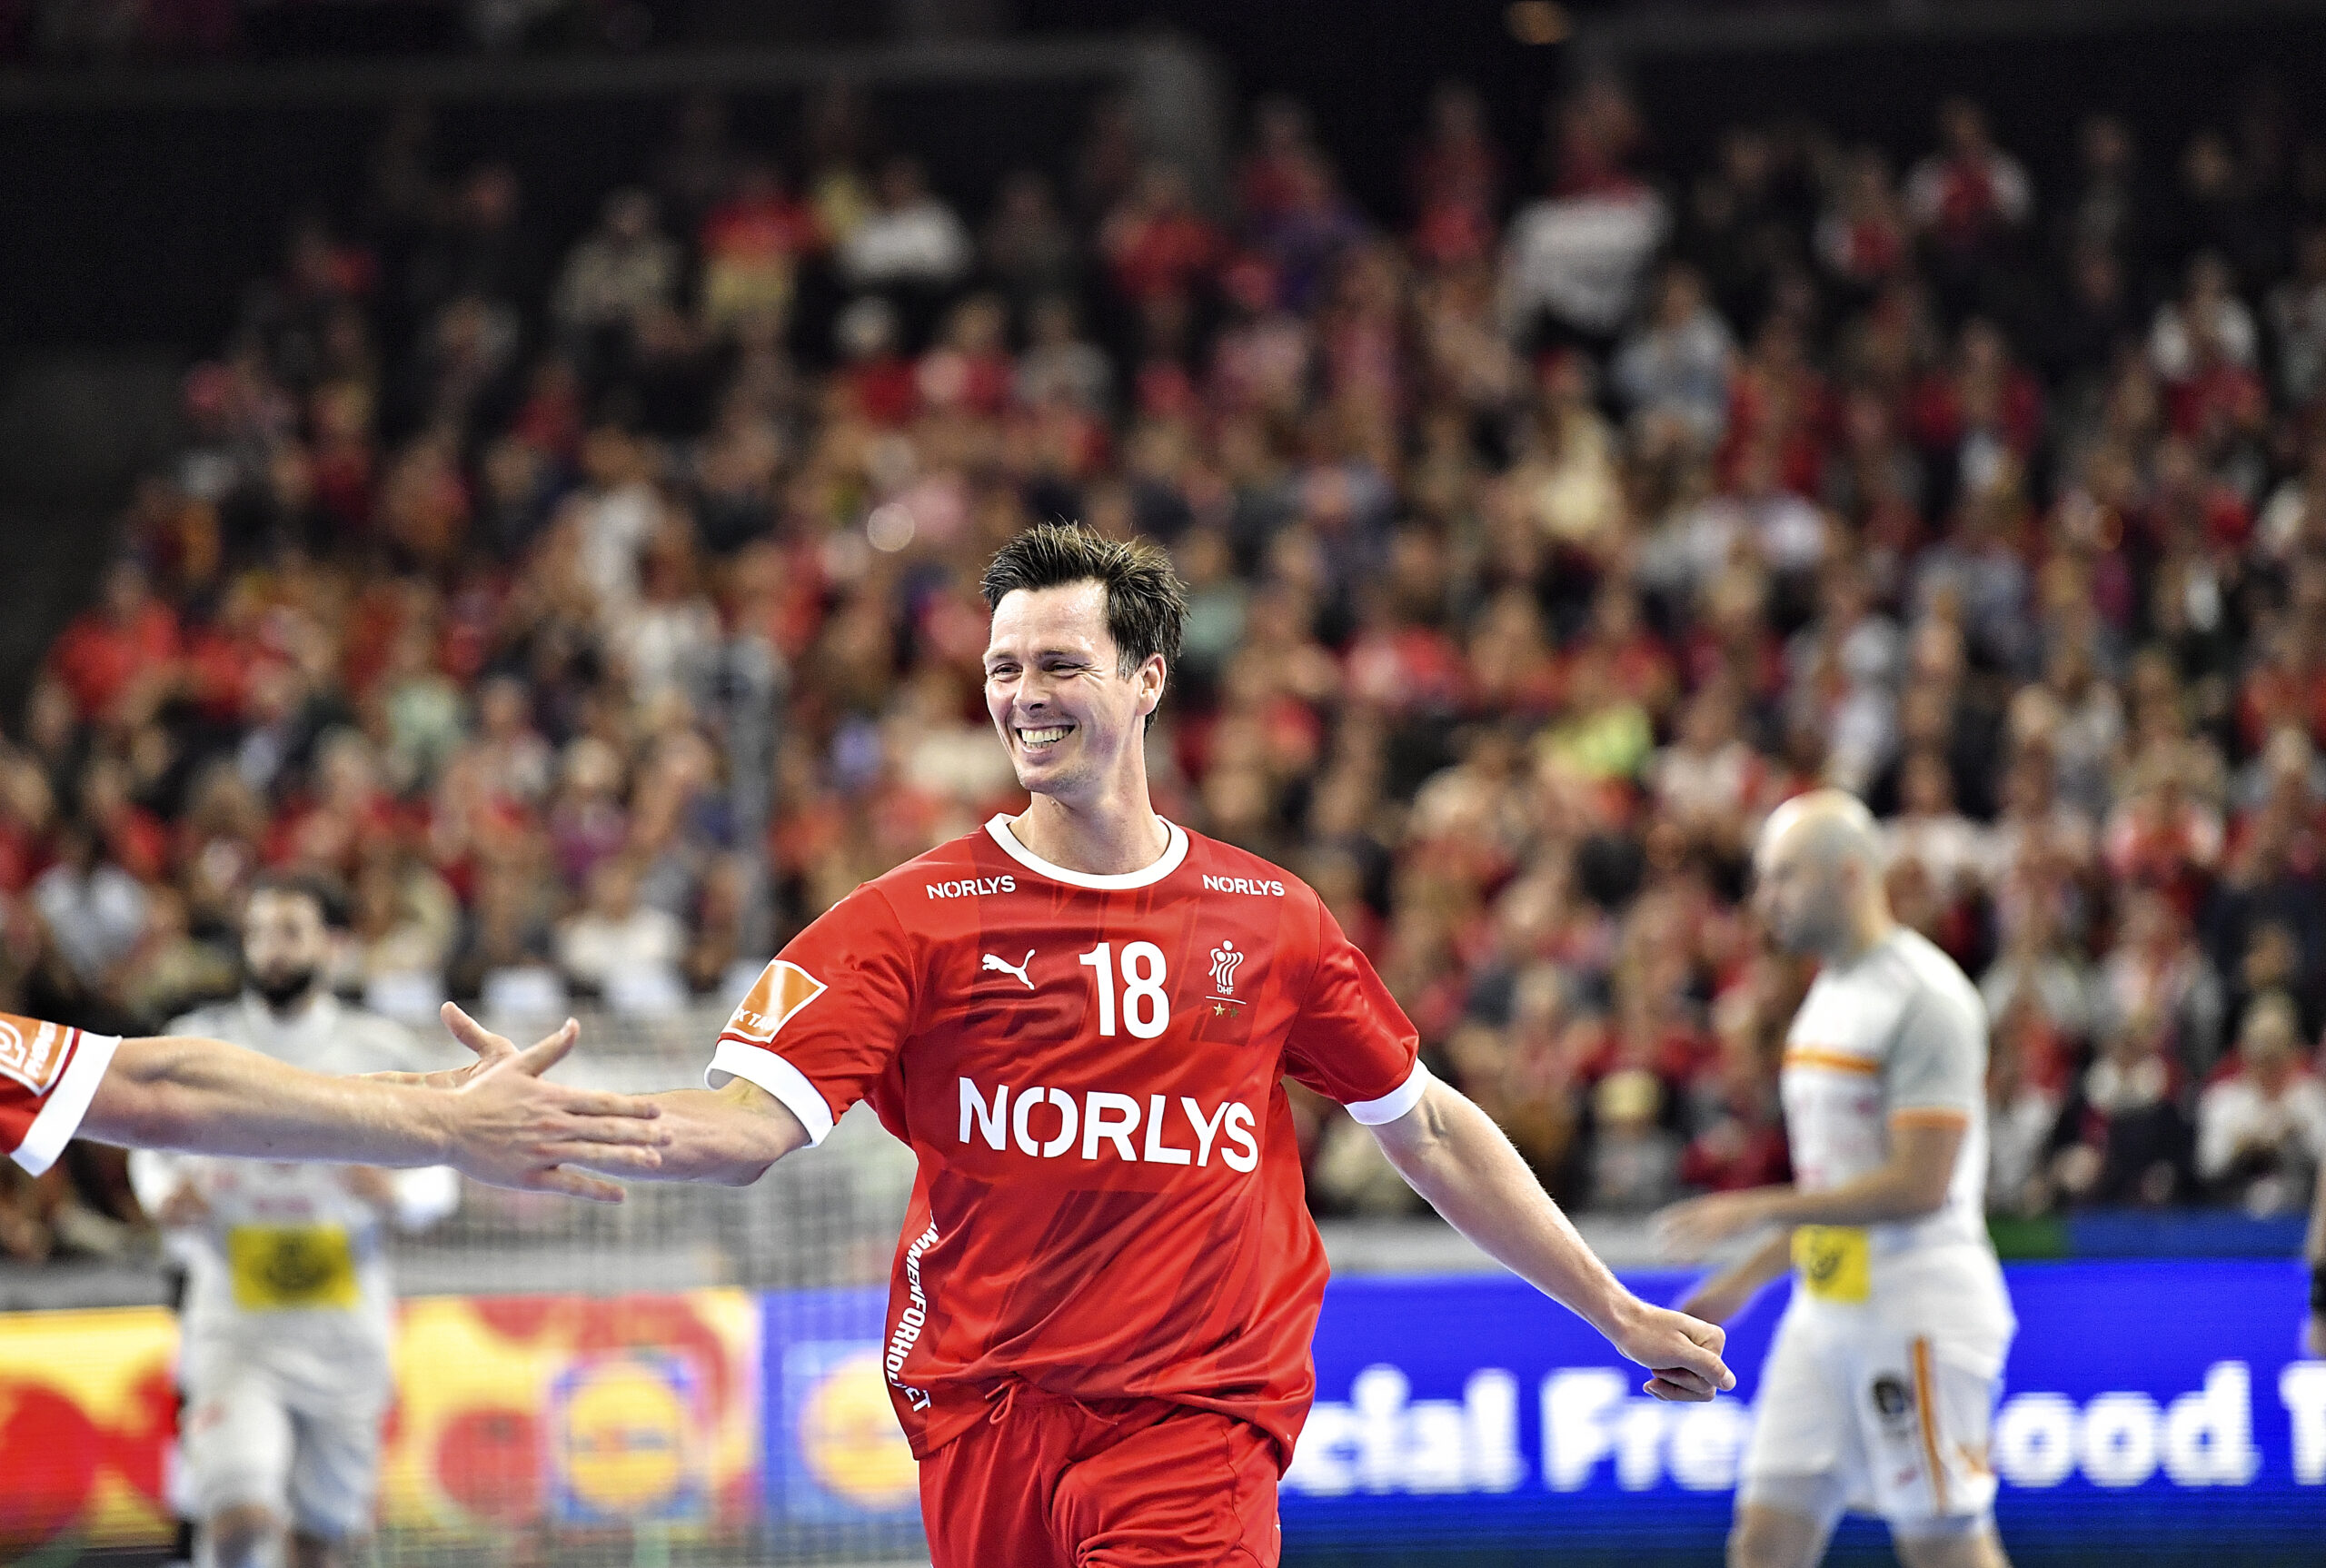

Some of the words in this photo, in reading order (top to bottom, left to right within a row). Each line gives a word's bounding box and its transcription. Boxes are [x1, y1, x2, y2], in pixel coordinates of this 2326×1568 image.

[925, 875, 1016, 899] NORLYS
[1202, 874, 1286, 897] NORLYS
[1079, 941, 1170, 1039] 18
[1217, 984, 1234, 996] DHF
[959, 1077, 1258, 1173] NORLYS
